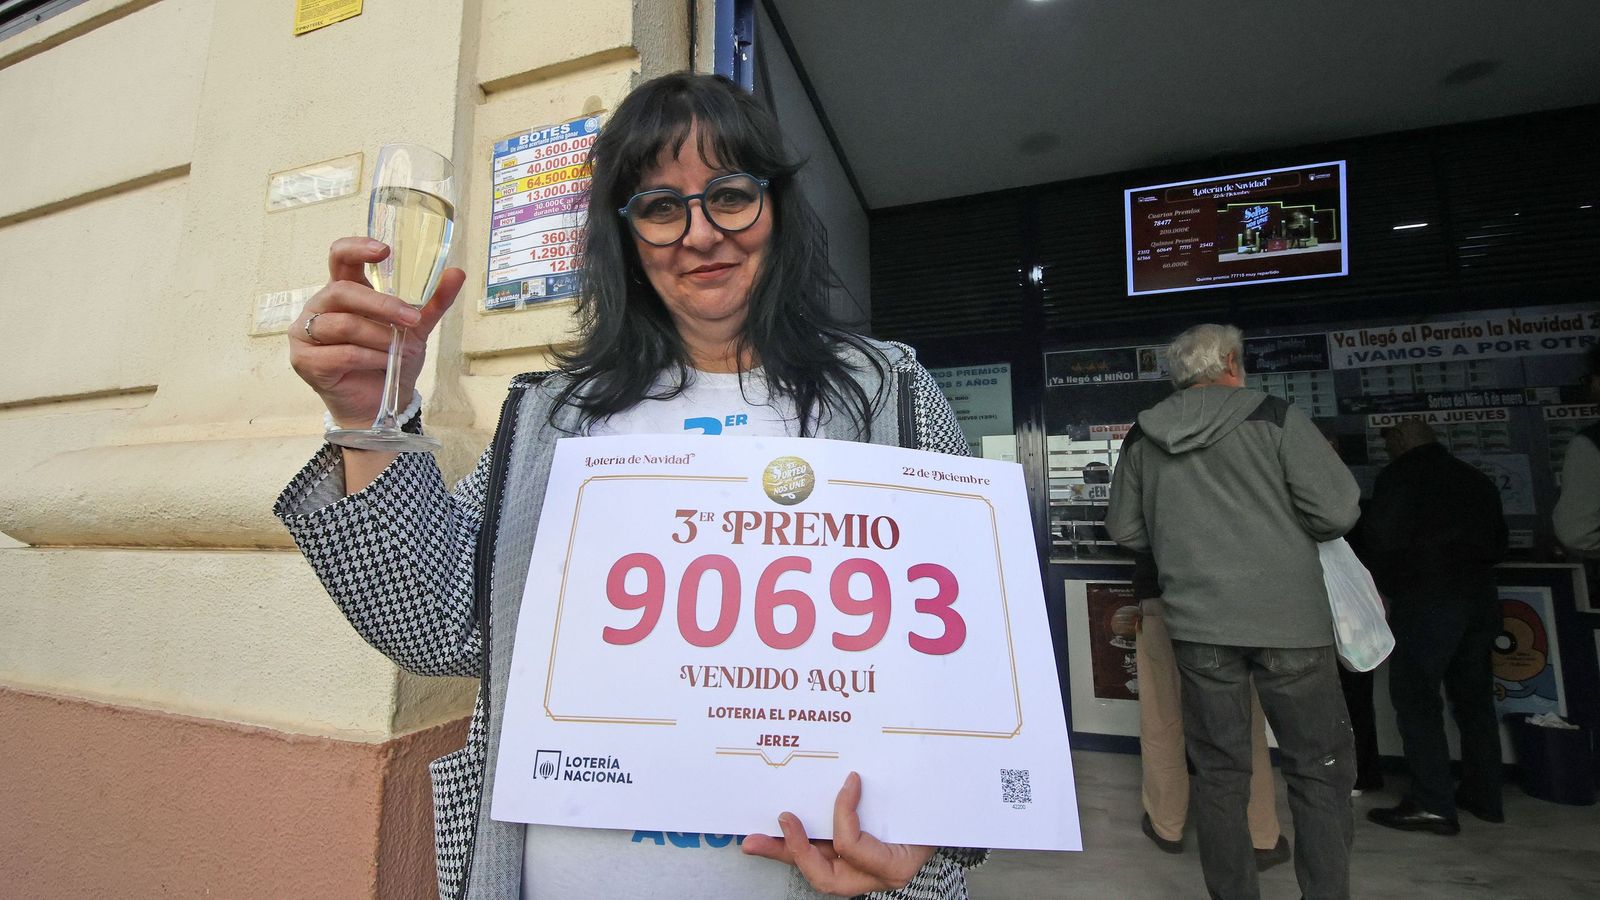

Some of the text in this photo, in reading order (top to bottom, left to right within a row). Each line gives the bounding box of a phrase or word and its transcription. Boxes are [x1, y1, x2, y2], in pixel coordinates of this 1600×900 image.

[519, 123, 571, 145] BOTES
[565, 131, 579, 140] ganar
[534, 136, 597, 159] 3.600.000
[527, 152, 591, 174] 40.000.00
[1234, 177, 1271, 190] Navidad
[534, 206, 560, 216] durante
[542, 228, 588, 245] 360.0
[530, 244, 587, 260] 1.290.0
[550, 257, 586, 272] 12.0
[1334, 332, 1356, 348] Ya
[1360, 328, 1397, 348] llegó
[1402, 328, 1416, 343] al
[1422, 322, 1483, 342] Paraíso
[1487, 320, 1504, 336] la
[1508, 314, 1584, 335] Navidad
[1346, 344, 1442, 366] ¡VAMOS
[1452, 341, 1469, 356] A
[1478, 338, 1530, 354] POR
[956, 366, 1008, 376] PREMIOS
[1105, 371, 1134, 381] NIÑO!
[966, 378, 998, 387] AÑOS
[1372, 409, 1506, 426] LOTERIA JUEVES
[628, 454, 641, 464] de
[644, 453, 696, 465] Navidad
[773, 465, 806, 480] SORTEO
[902, 466, 990, 486] 22 de Diciembre
[774, 479, 806, 495] NOS UNE
[722, 510, 900, 550] PREMIO
[602, 552, 967, 656] 90693
[680, 664, 876, 698] VENDIDO AQUÍ
[708, 706, 852, 723] LOTERIA EL PARAISO
[756, 734, 800, 748] JEREZ
[566, 756, 620, 770] LOTERÍA
[564, 770, 633, 784] NACIONAL
[632, 830, 746, 848] AQU
